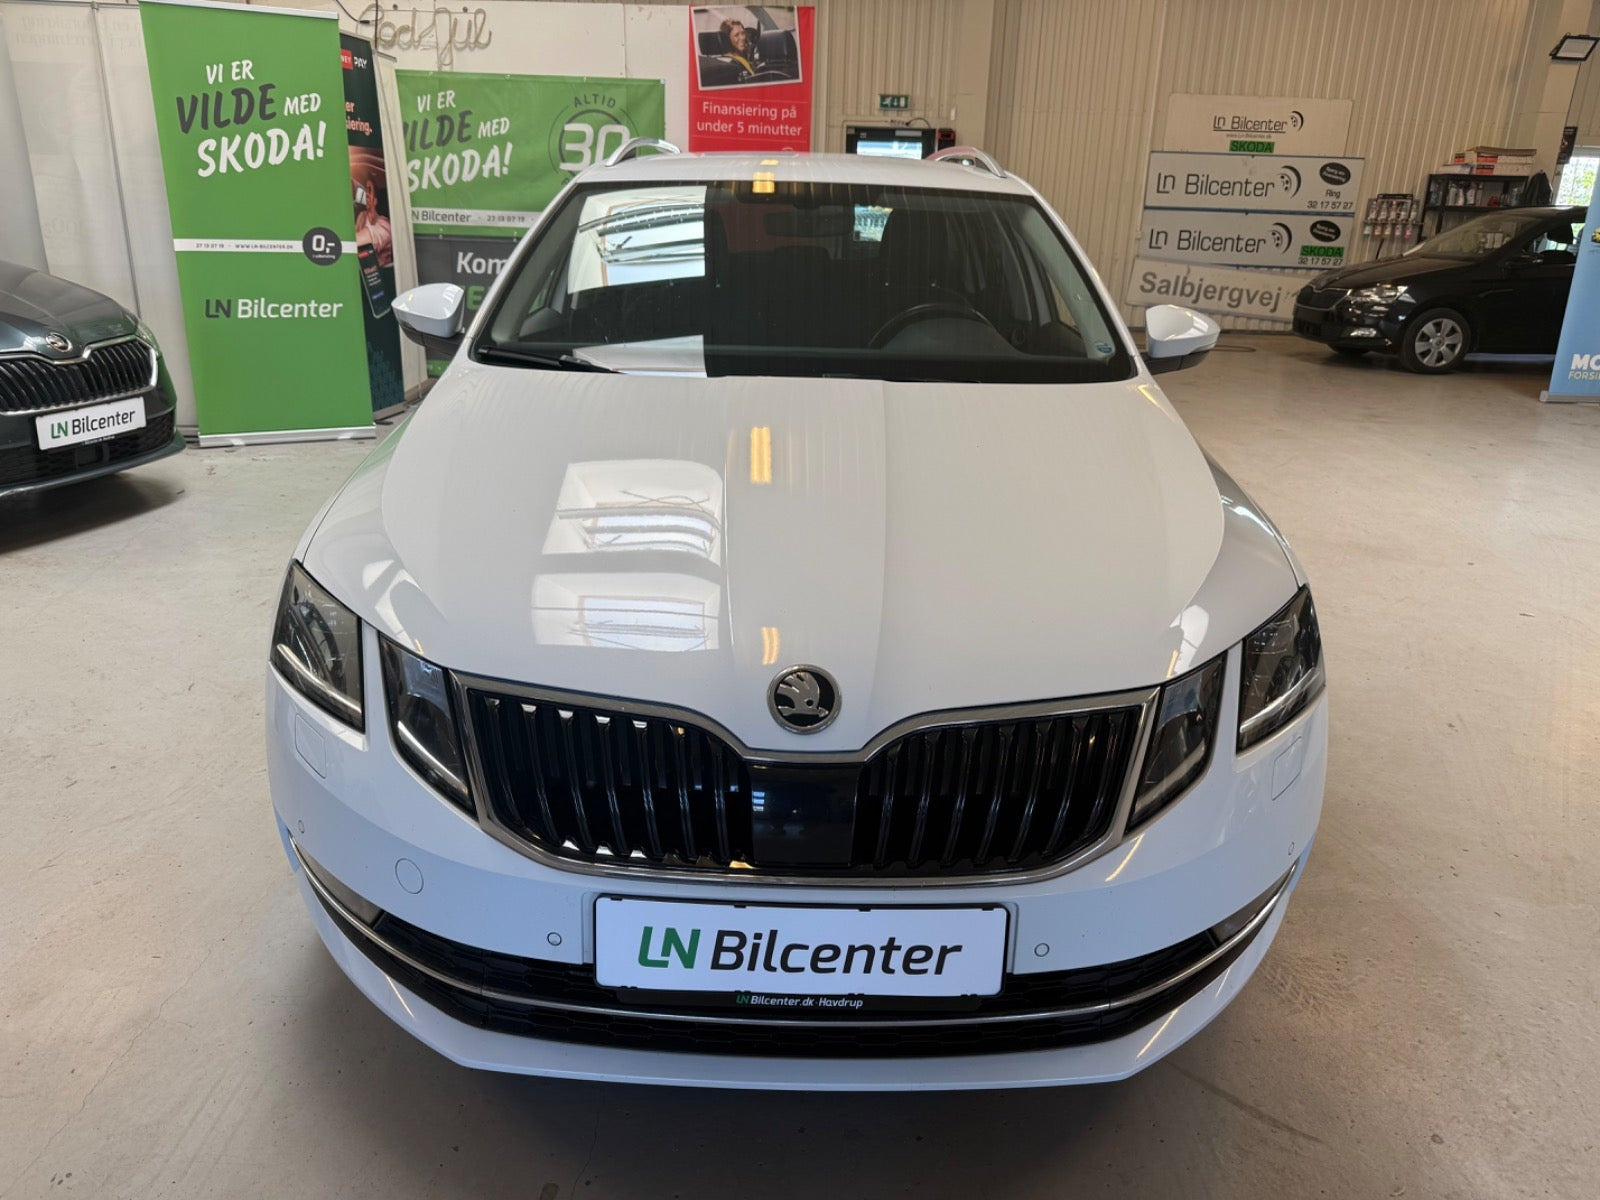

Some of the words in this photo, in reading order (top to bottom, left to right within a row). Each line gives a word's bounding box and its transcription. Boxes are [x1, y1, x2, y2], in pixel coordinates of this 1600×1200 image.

[205, 63, 223, 85] VI
[231, 59, 254, 81] ER
[176, 83, 277, 134] VILDE
[284, 92, 321, 116] MED
[417, 94, 431, 113] VI
[437, 90, 456, 109] ER
[573, 93, 616, 108] ALTID
[702, 101, 778, 120] Finansiering
[781, 105, 797, 120] på
[346, 116, 373, 136] iering.
[478, 116, 510, 139] MED
[697, 120, 733, 133] under
[737, 121, 744, 133] 5
[748, 122, 802, 136] minutter
[1231, 115, 1288, 131] Bilcenter
[197, 120, 327, 178] SKODA!
[559, 123, 630, 171] 30
[1230, 140, 1274, 153] SKODA
[407, 141, 513, 193] SKODA!
[1184, 173, 1275, 197] Bilcenter
[1325, 189, 1341, 200] Ring
[1320, 201, 1330, 209] 17
[421, 210, 472, 223] Bilcenter
[1177, 230, 1266, 253] Bilcenter
[1301, 245, 1343, 257] SKODA
[1139, 271, 1282, 313] Salbjergvej
[205, 299, 231, 318] LN
[237, 297, 344, 319] Bilcenter
[51, 420, 69, 439] LN
[72, 410, 136, 436] Bilcenter
[637, 925, 701, 969] LN
[710, 929, 963, 976] Bilcenter
[750, 995, 815, 1007] Bilcenter.dk
[818, 997, 864, 1009] Havdrup
